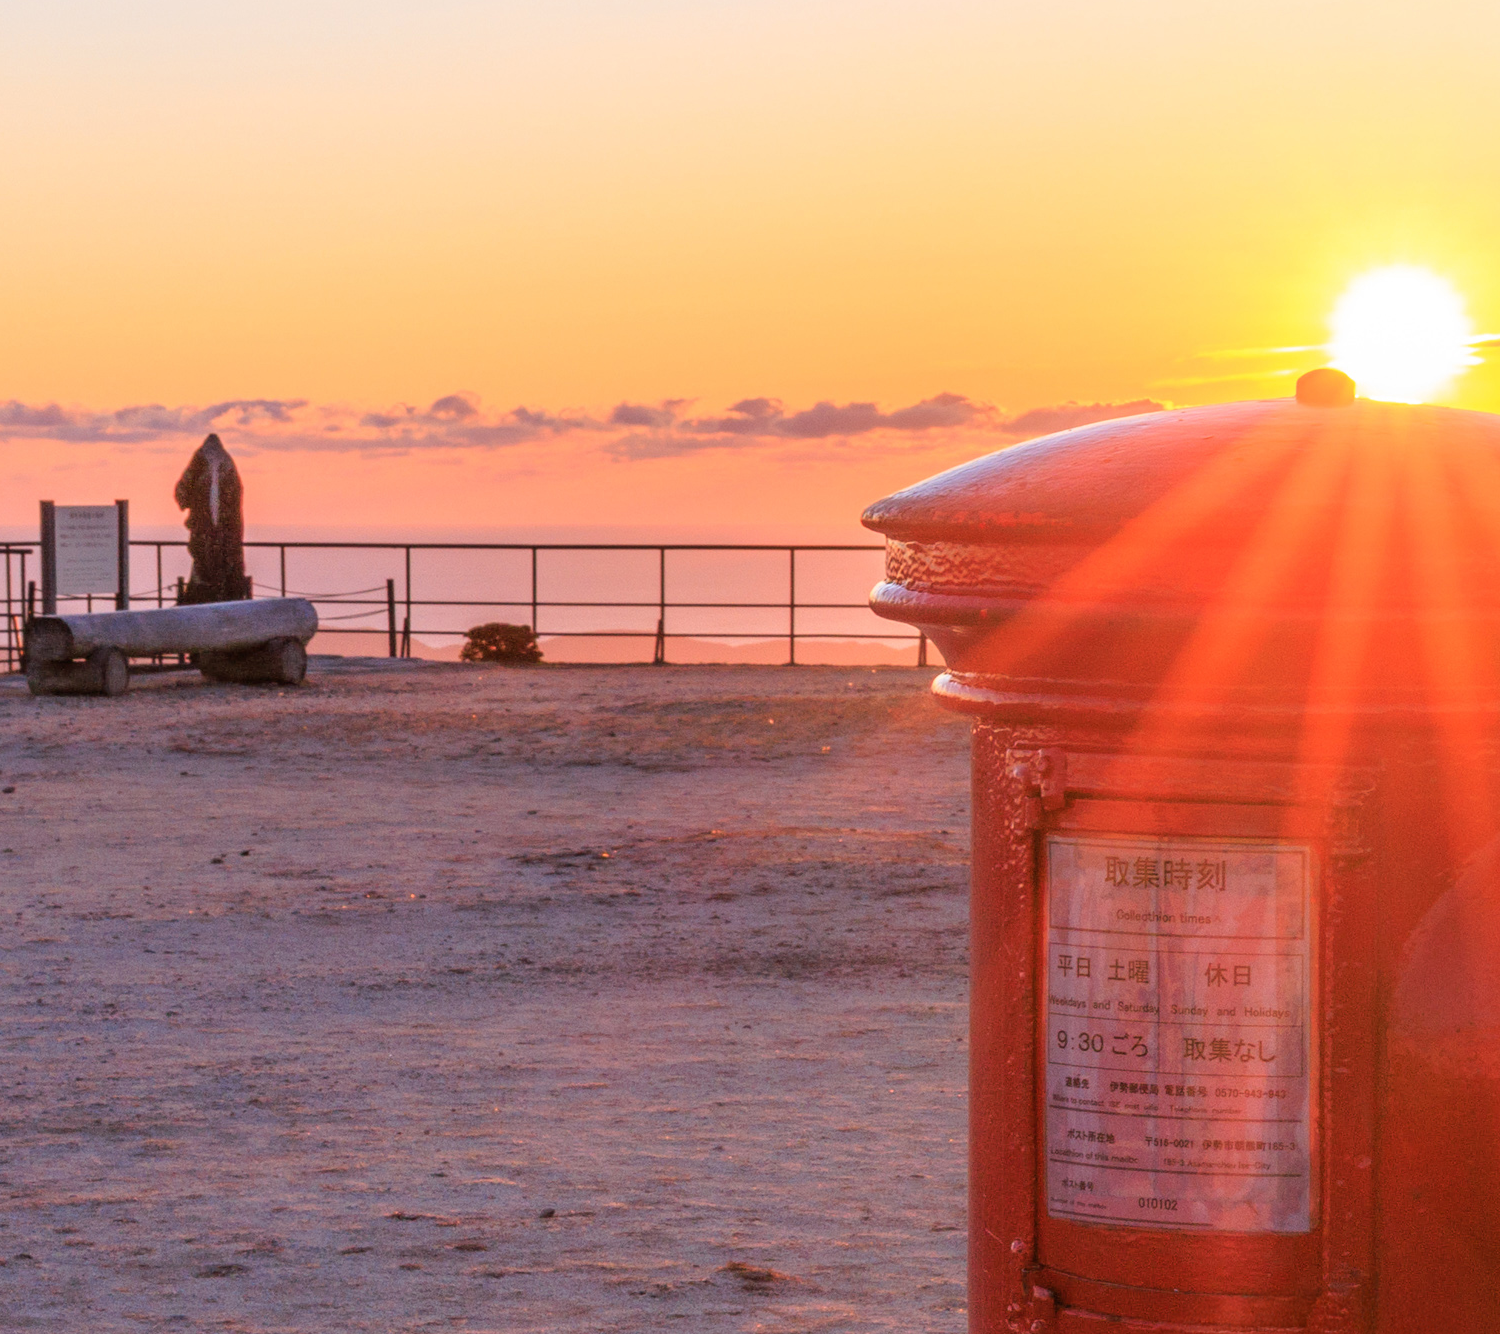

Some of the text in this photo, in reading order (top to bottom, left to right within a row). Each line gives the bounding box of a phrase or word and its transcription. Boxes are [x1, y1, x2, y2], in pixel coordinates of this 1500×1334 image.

[1105, 856, 1226, 891] 取集時刻
[1180, 912, 1212, 924] times
[1057, 954, 1149, 984] 平日 土曜
[1204, 963, 1251, 987] 休日
[1048, 994, 1160, 1015] Weekdays and Saturday
[1170, 1004, 1290, 1019] Sunday and Holidays
[1057, 1030, 1149, 1057] 9:30 ごろ
[1183, 1037, 1276, 1063] 取集なし
[1138, 1197, 1178, 1211] 010102
